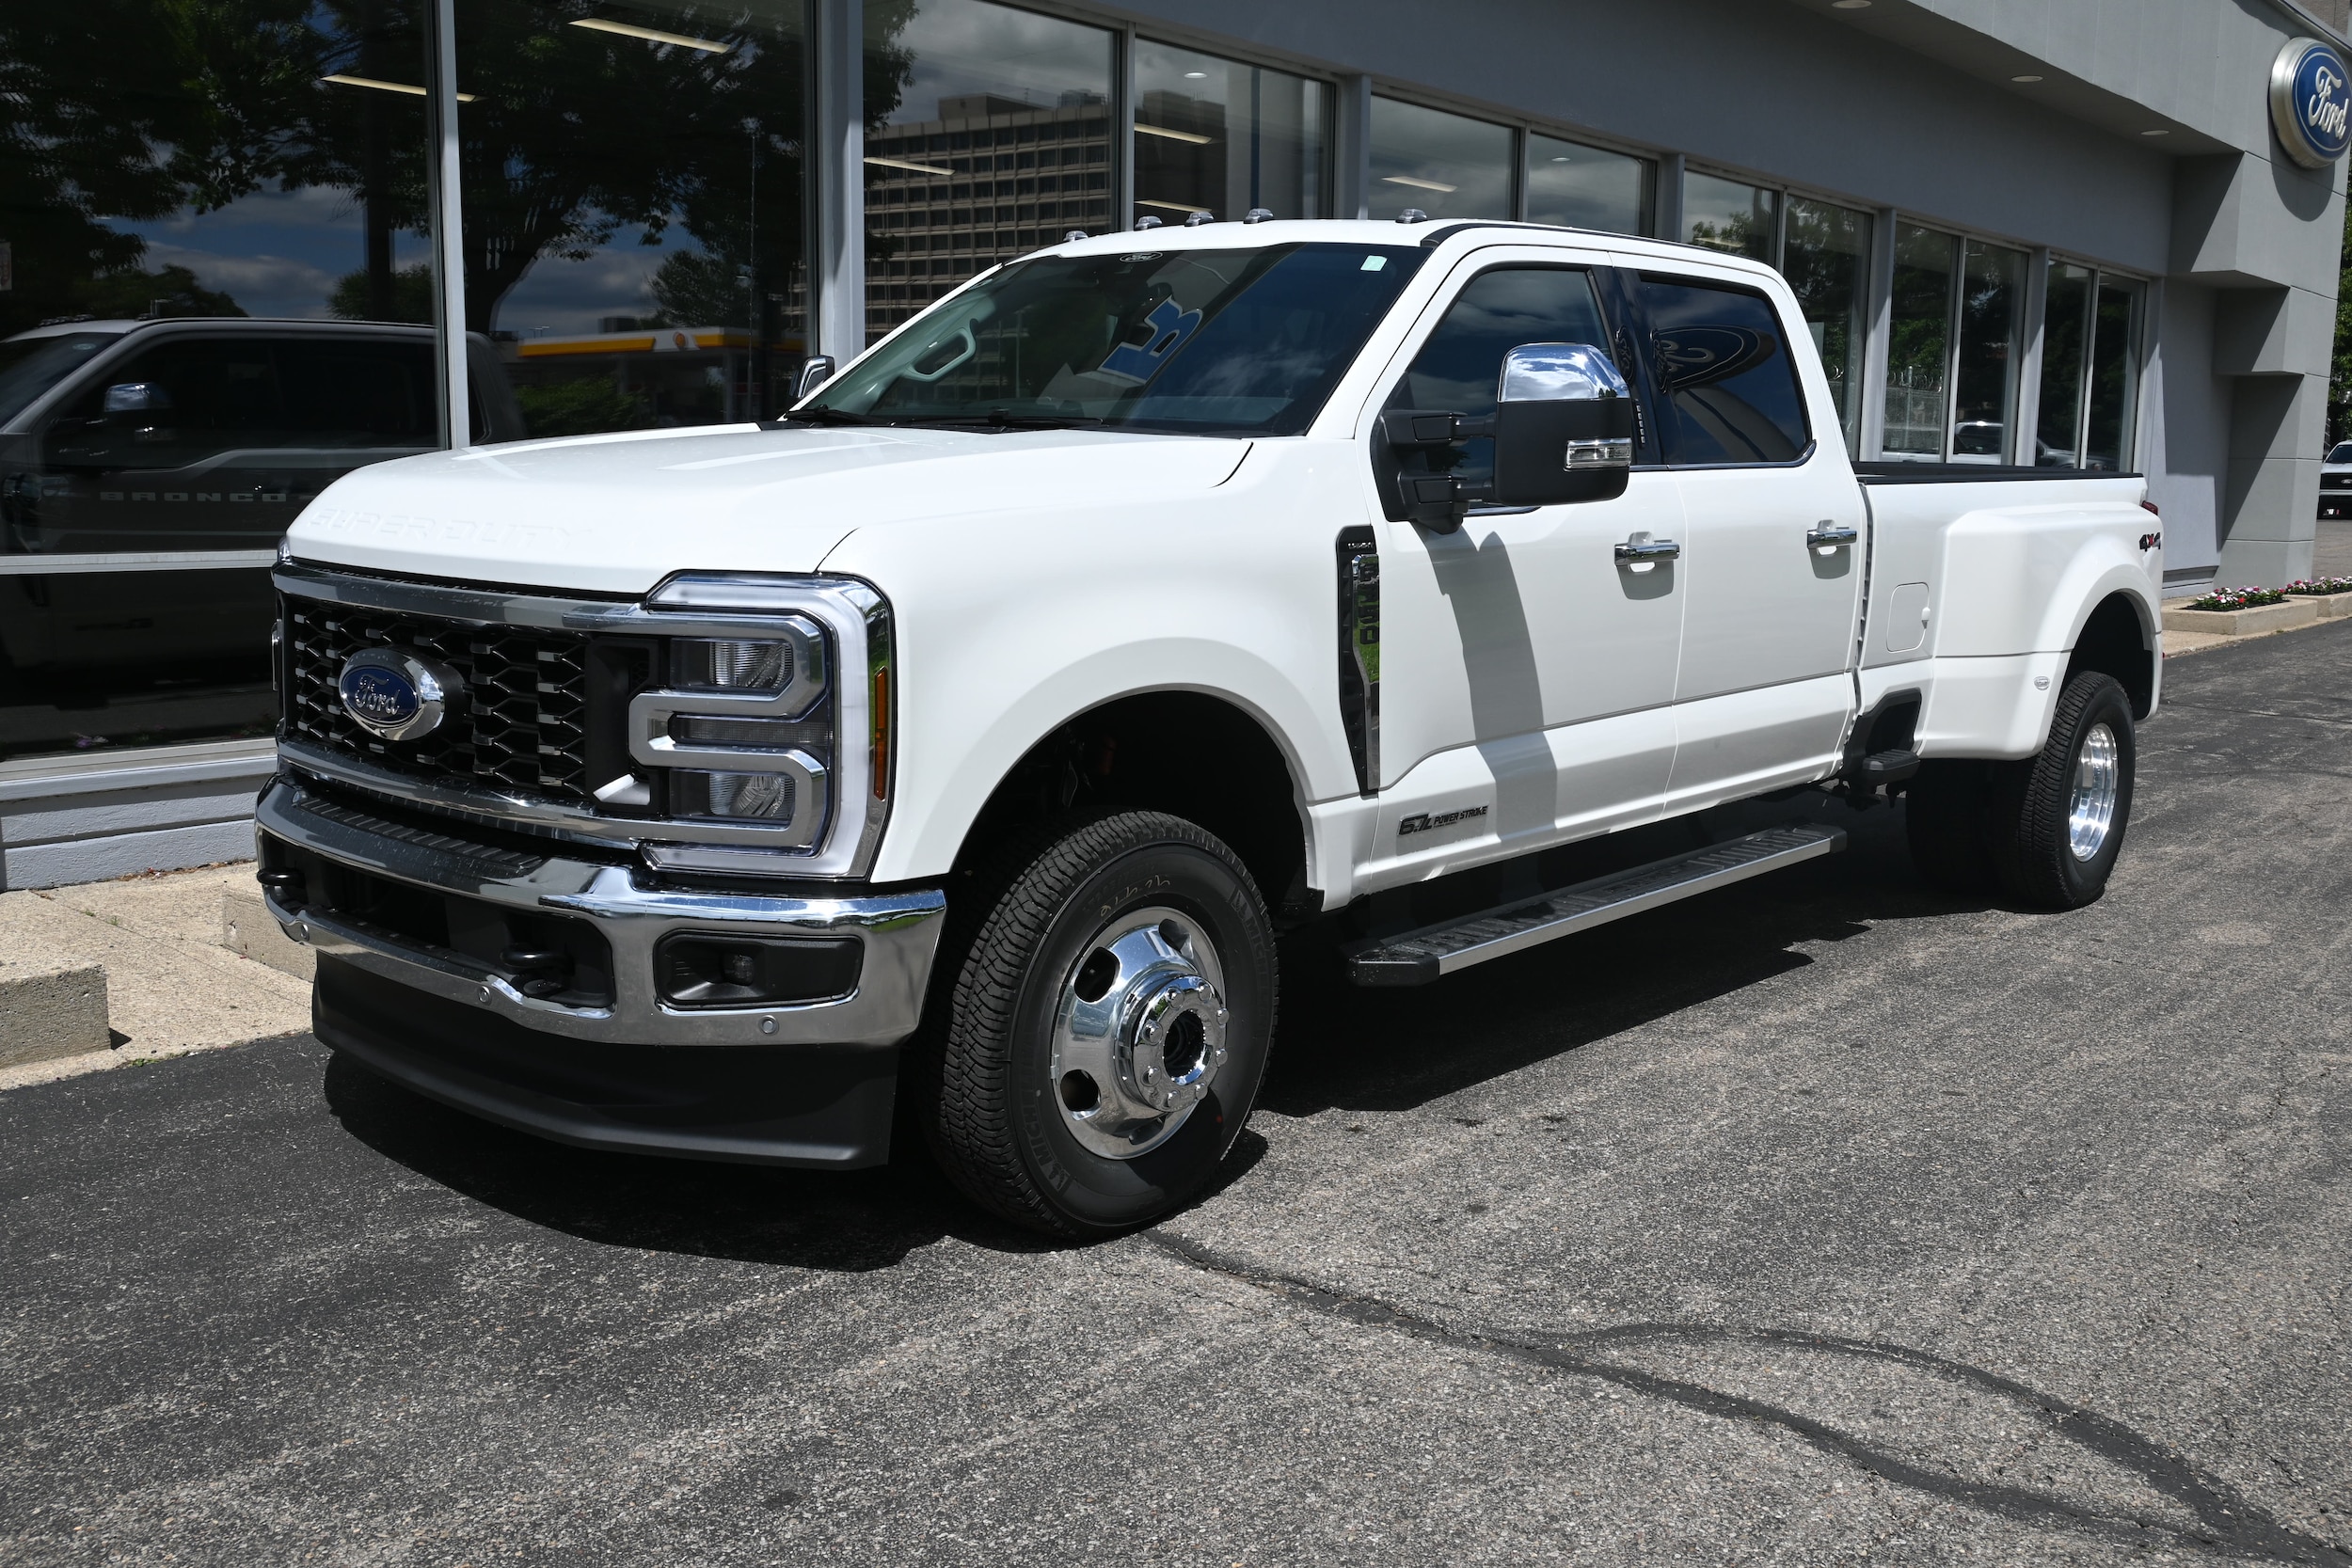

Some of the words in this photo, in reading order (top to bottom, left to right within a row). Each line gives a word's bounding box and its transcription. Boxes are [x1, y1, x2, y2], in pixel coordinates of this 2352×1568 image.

[2308, 66, 2349, 140] Ford
[100, 491, 286, 502] BRONCO
[308, 508, 436, 540] SUPER
[437, 518, 592, 550] DUTY
[355, 674, 400, 715] Ford
[1433, 812, 1459, 825] POWER
[1459, 805, 1488, 820] STROKE
